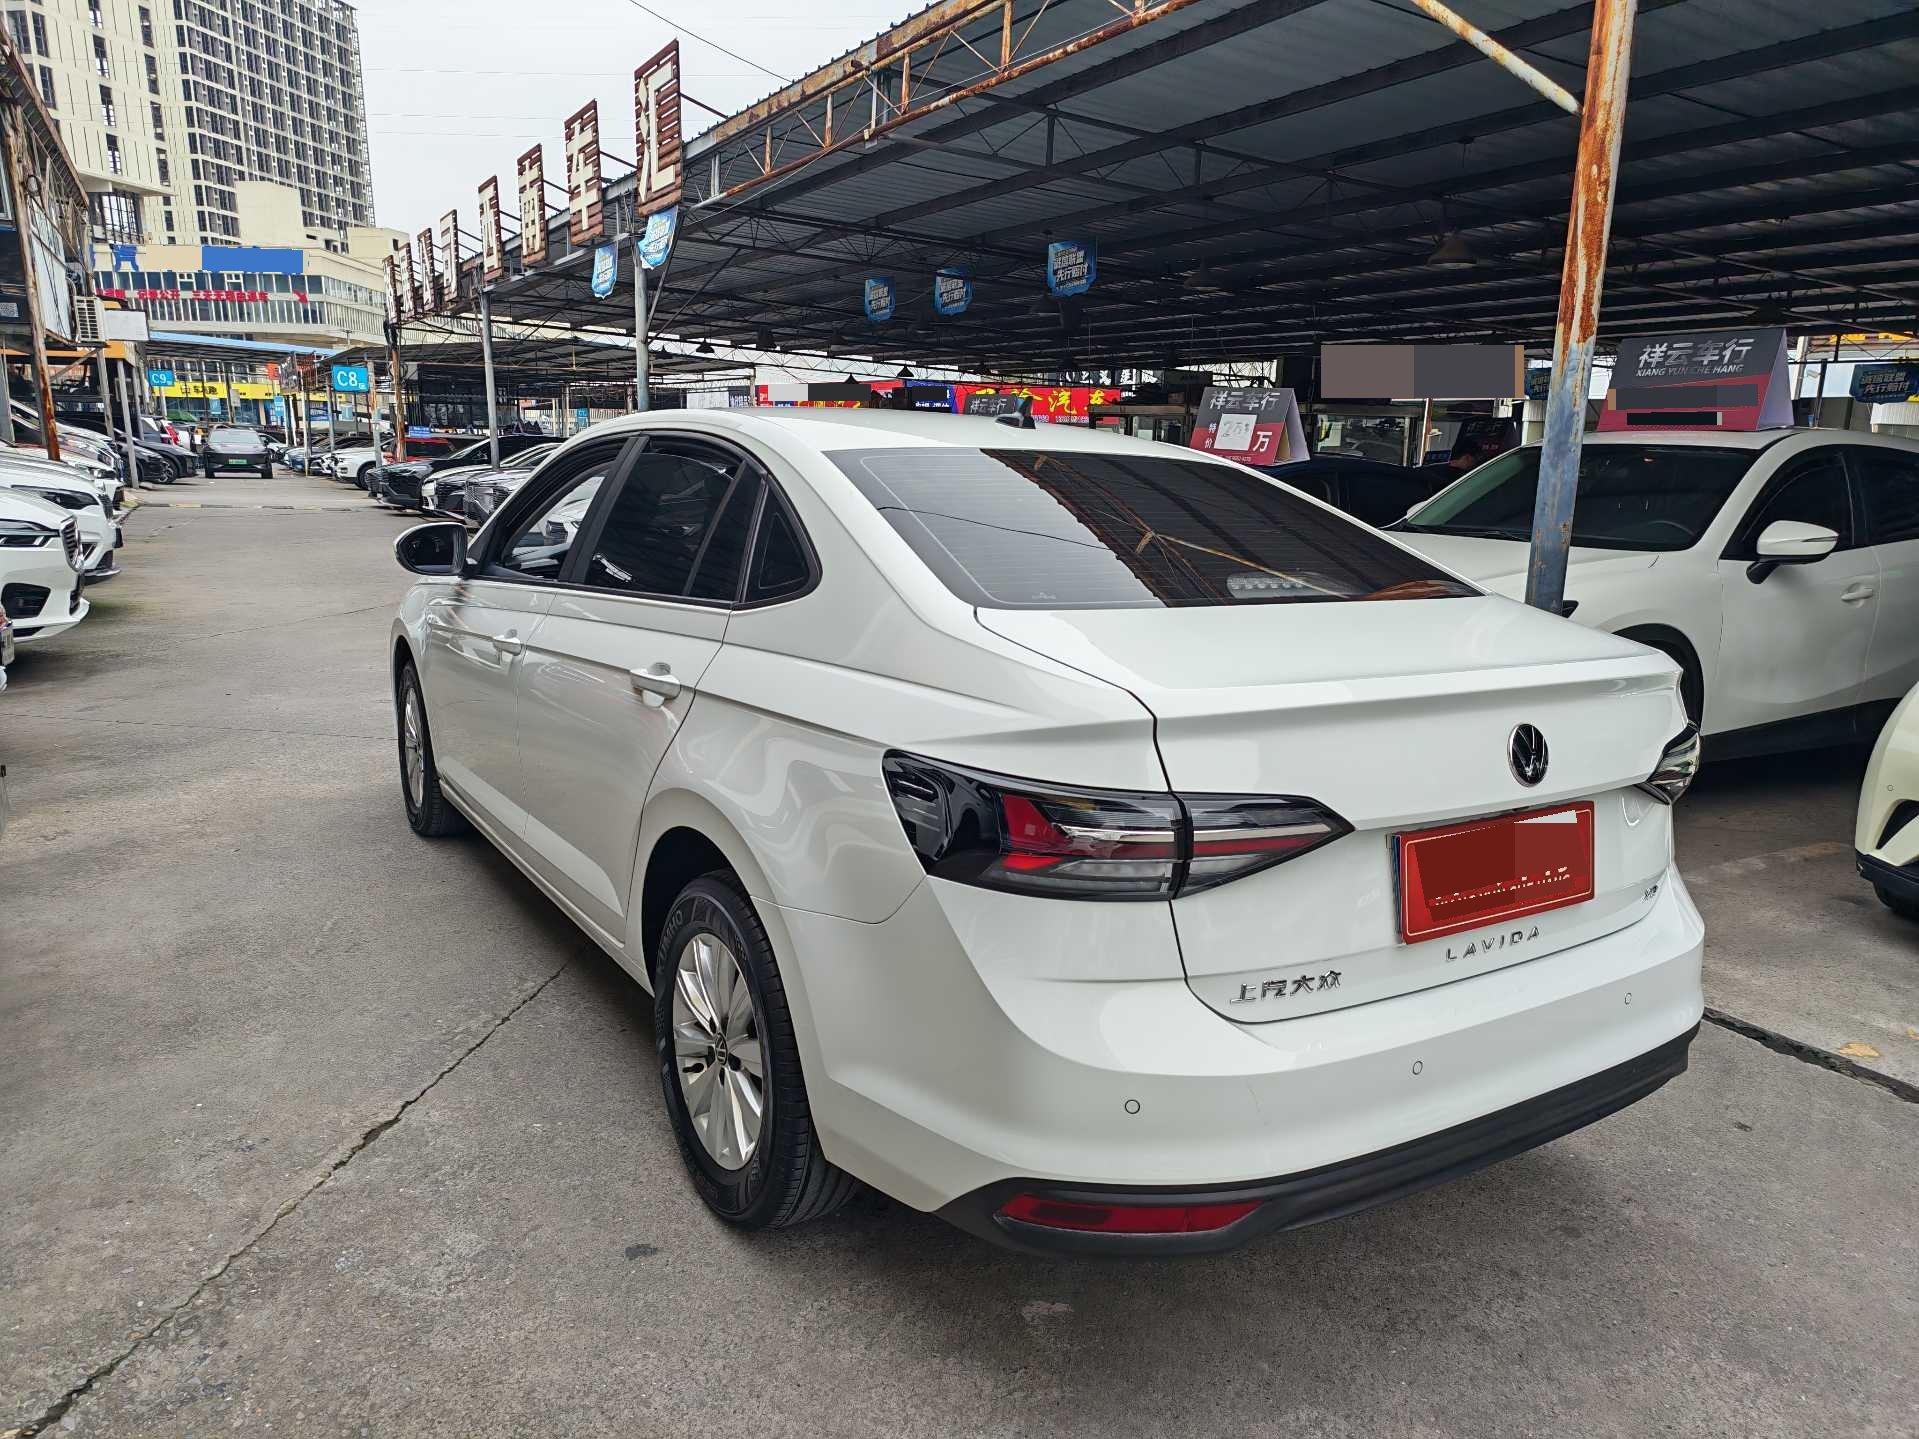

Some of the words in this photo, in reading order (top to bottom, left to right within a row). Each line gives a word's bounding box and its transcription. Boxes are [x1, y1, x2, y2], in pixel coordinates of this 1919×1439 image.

[1638, 337, 1756, 368] 祥云车行
[1636, 367, 1667, 377] XIANG
[1712, 364, 1745, 374] HANG
[1209, 390, 1281, 411] 祥云车行
[1204, 423, 1217, 449] 特价
[1252, 431, 1273, 452] 万
[1445, 925, 1541, 962] LAVIDA
[1229, 970, 1342, 1004] 上汽大众
